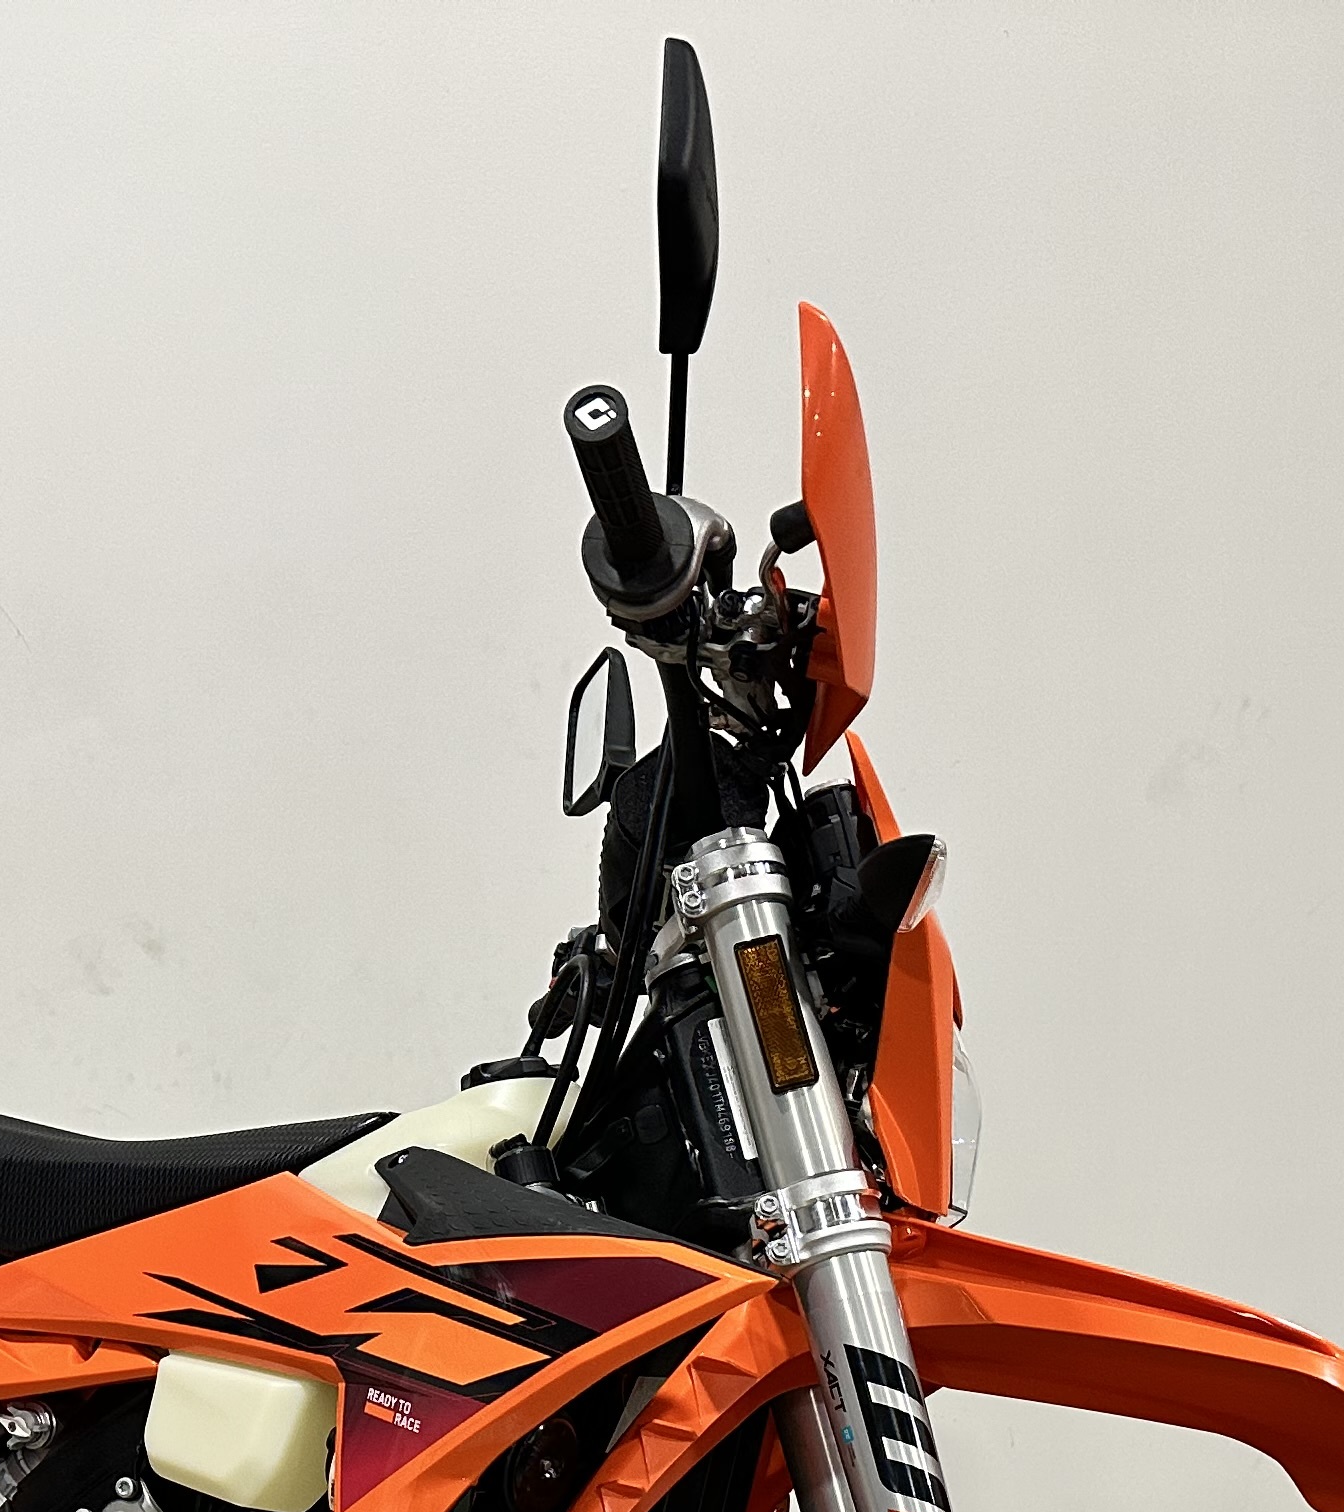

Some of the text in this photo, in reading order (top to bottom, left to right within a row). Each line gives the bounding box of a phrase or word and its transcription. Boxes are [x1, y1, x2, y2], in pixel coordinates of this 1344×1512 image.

[820, 1349, 846, 1413] XACT
[367, 1387, 412, 1415] READY TO
[393, 1412, 421, 1433] RACE
